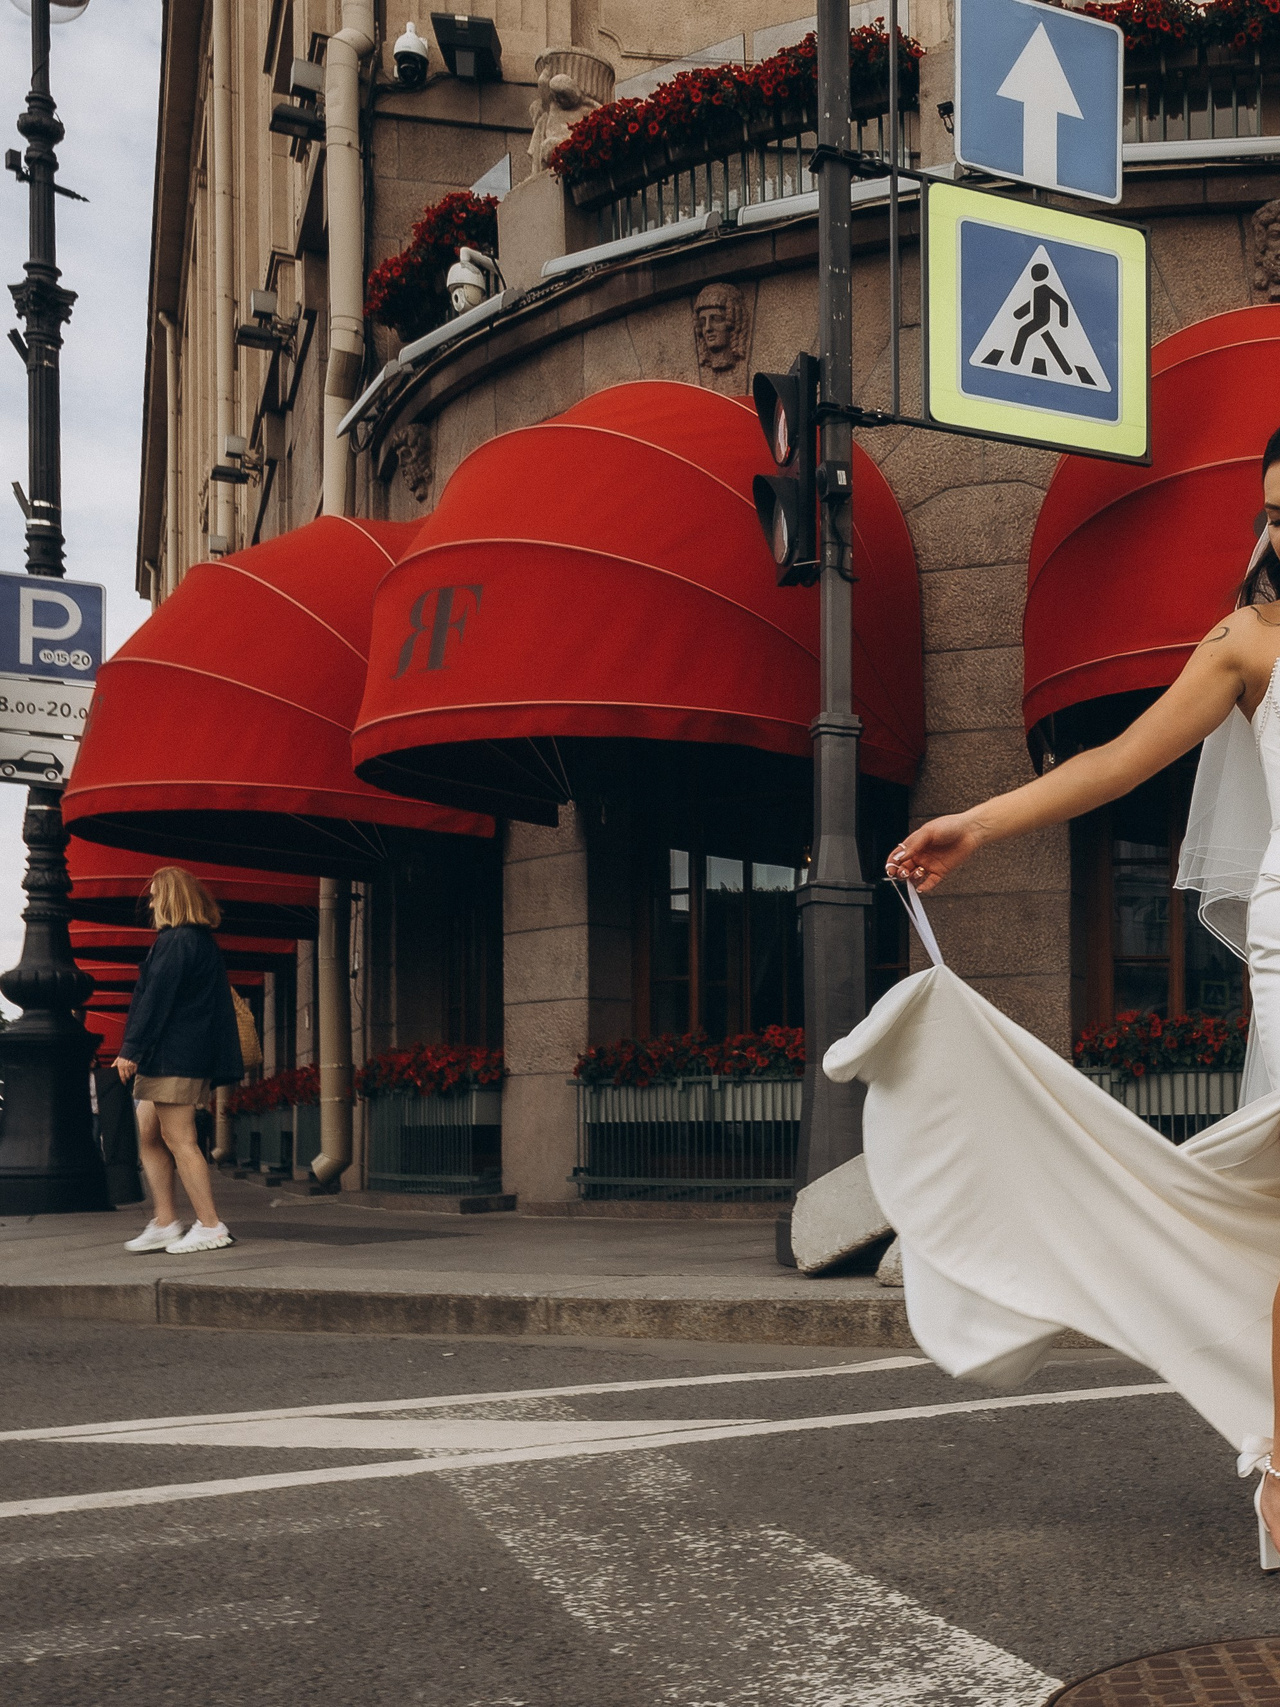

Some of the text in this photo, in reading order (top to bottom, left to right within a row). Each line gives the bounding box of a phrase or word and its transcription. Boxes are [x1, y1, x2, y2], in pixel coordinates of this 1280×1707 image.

[19, 586, 82, 666] P
[43, 652, 90, 666] 10 15 20
[0, 696, 88, 719] 8.00-20.0
